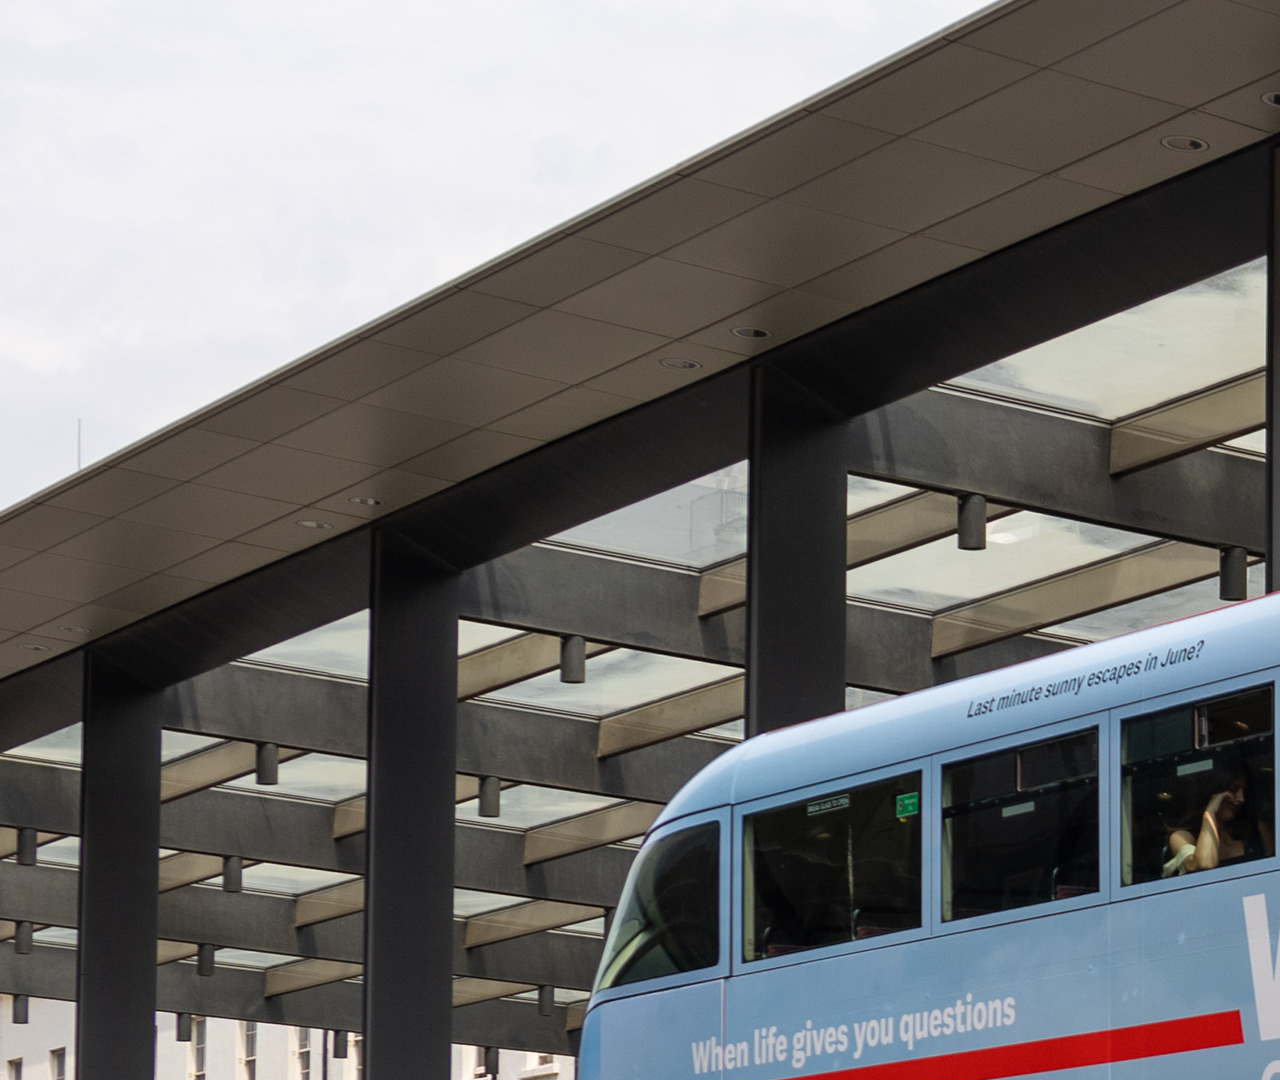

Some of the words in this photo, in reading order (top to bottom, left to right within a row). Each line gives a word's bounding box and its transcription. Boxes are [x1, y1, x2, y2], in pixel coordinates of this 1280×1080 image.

[966, 700, 996, 719] Last
[996, 684, 1043, 711] minute
[1044, 674, 1084, 698] sunny
[1086, 658, 1142, 687] escapes
[1143, 652, 1158, 673] in
[1160, 639, 1205, 669] June?
[691, 1036, 749, 1076] When
[753, 1025, 787, 1066] life
[791, 1020, 848, 1069] gives
[853, 1017, 895, 1060] you
[899, 992, 1017, 1051] questions
